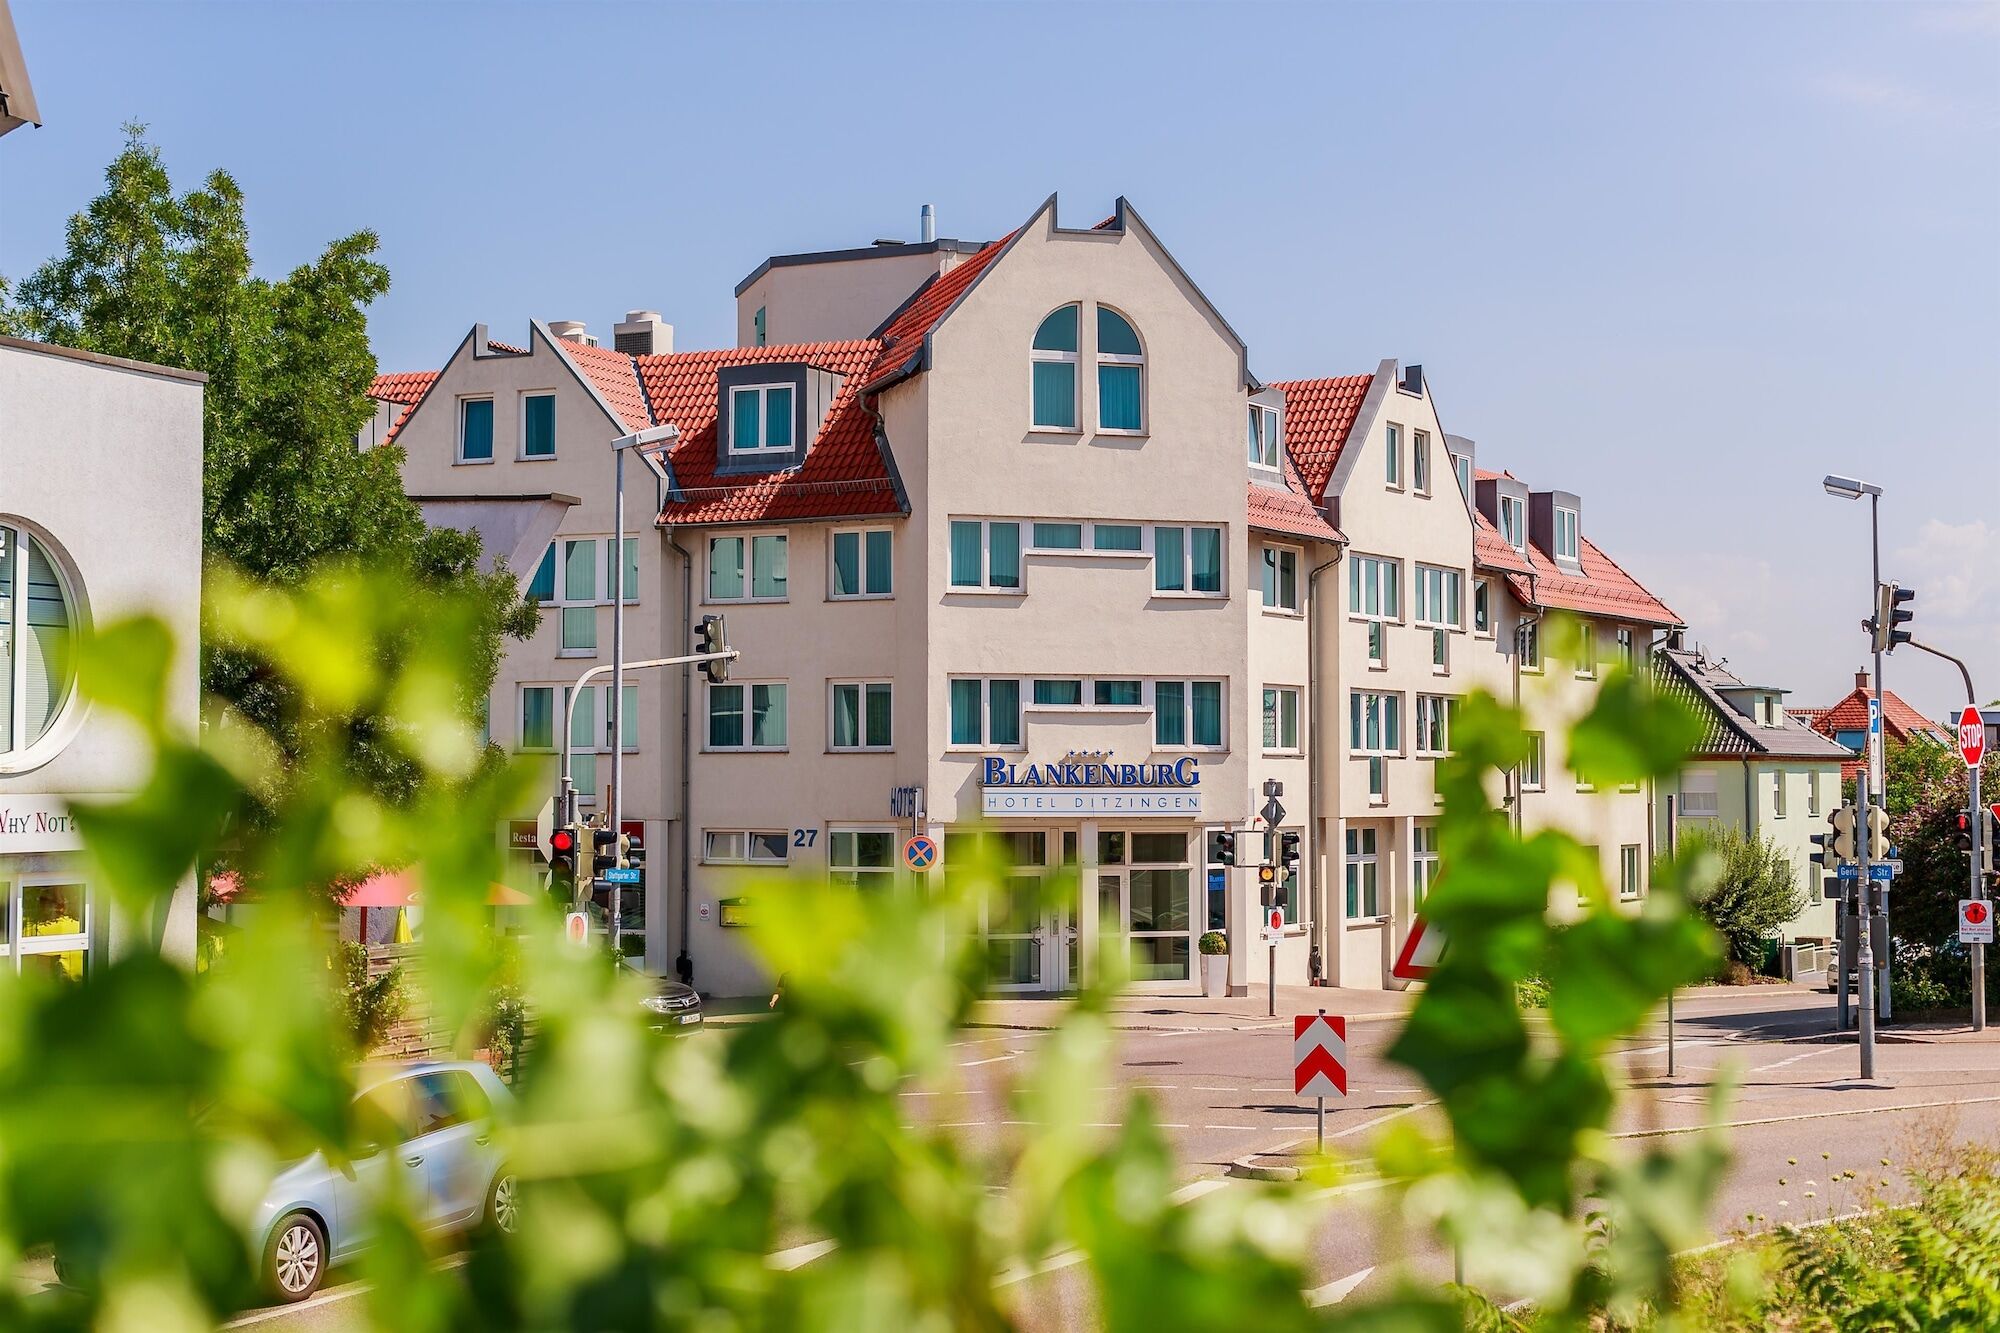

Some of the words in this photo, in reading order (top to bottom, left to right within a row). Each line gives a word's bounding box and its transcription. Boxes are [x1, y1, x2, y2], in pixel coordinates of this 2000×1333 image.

[1961, 723, 1983, 750] STOP
[983, 756, 1201, 787] BLANKENBURG
[890, 787, 915, 817] HOTE
[988, 797, 1056, 808] HOTEL
[1075, 797, 1198, 808] DITZINGEN
[513, 832, 537, 843] Resta
[794, 829, 818, 848] 27
[1840, 867, 1874, 876] Gerlir
[1877, 868, 1890, 877] Str.
